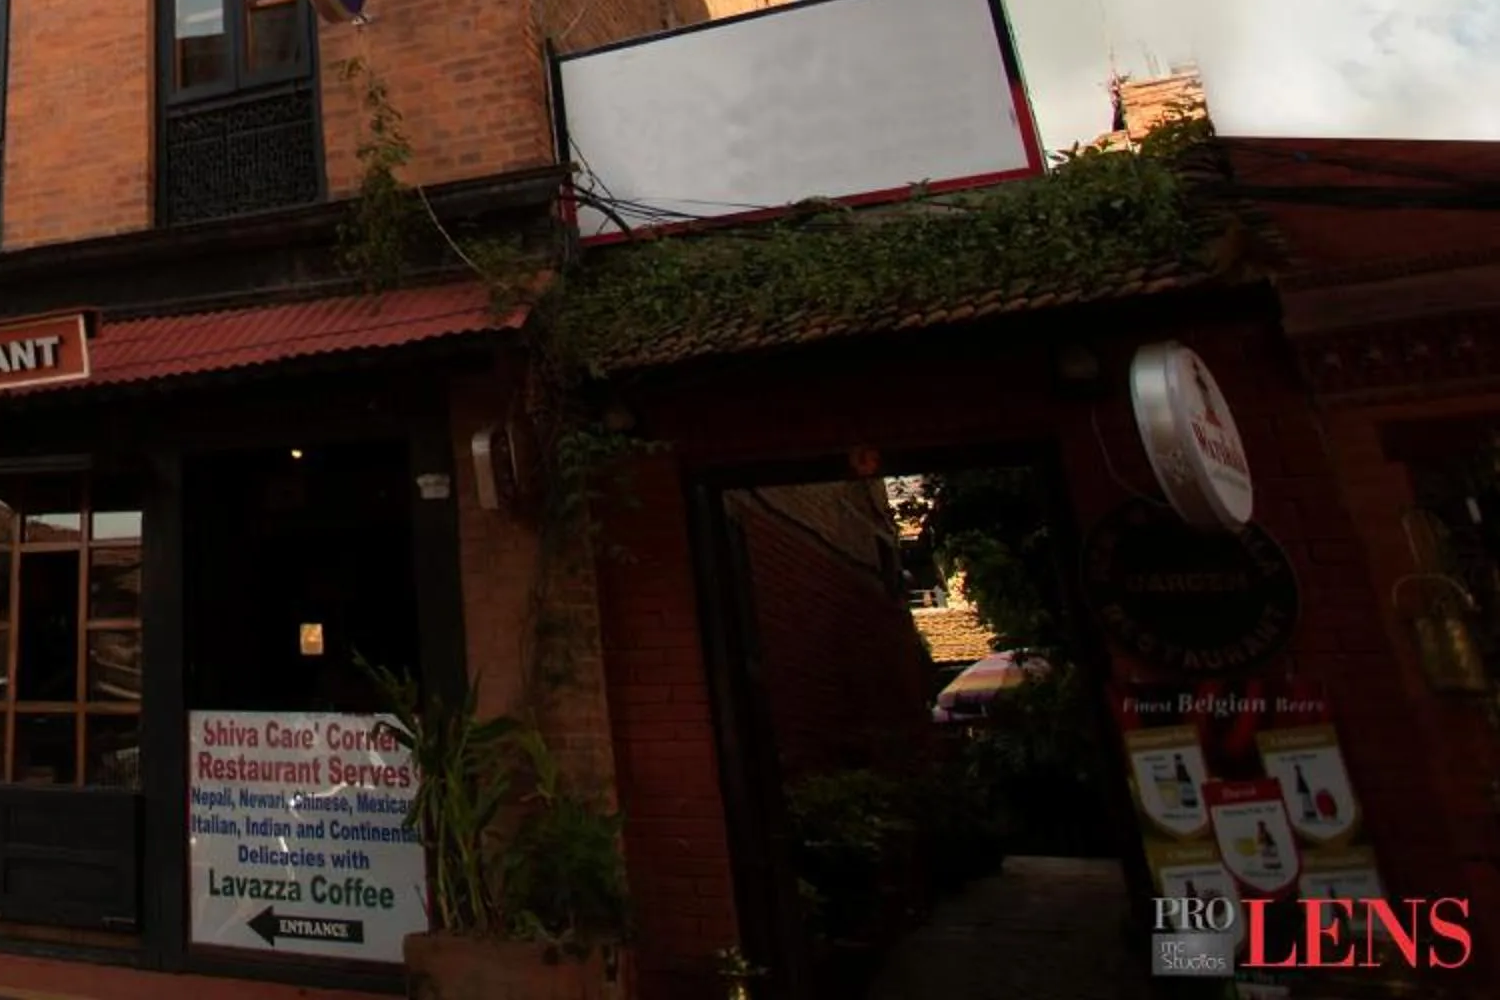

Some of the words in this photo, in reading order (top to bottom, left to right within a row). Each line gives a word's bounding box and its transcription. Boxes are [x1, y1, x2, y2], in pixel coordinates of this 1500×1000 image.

[1177, 692, 1266, 718] Belgian
[203, 718, 259, 748] Shiva
[198, 752, 322, 785] Restaurant
[328, 756, 411, 788] Serves
[246, 817, 291, 838] Indian
[296, 820, 325, 839] and
[238, 845, 325, 869] Delicacies
[331, 851, 370, 870] with
[208, 868, 302, 901] Lavazza
[310, 874, 395, 909] Coffee
[279, 919, 350, 937] ENTRANCE
